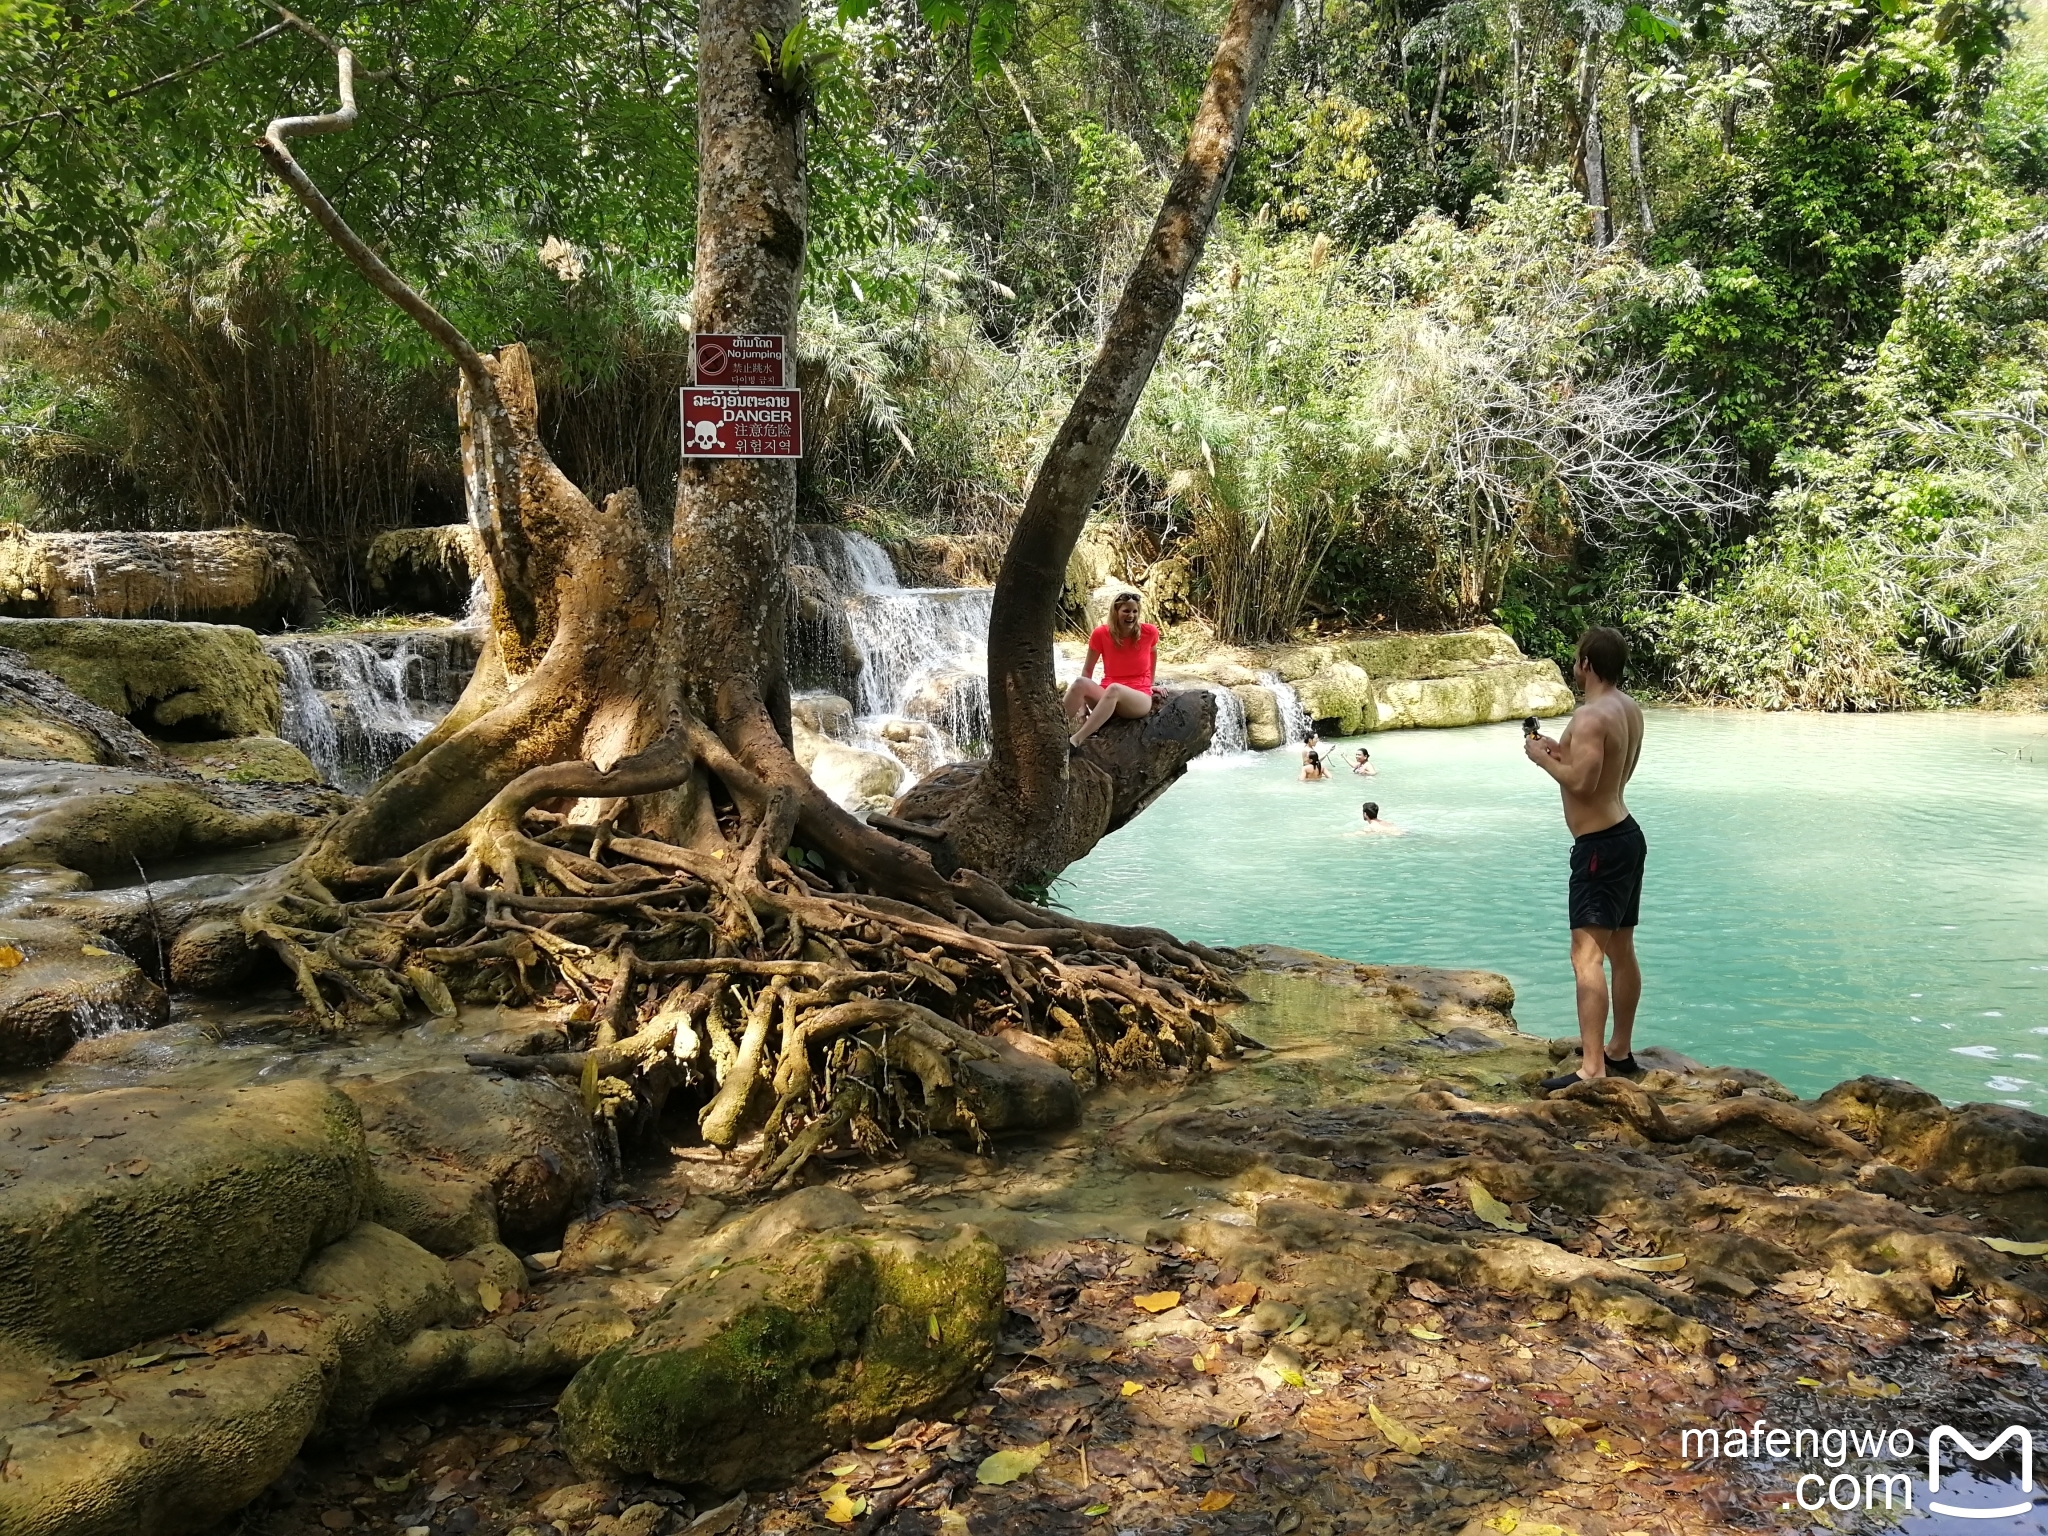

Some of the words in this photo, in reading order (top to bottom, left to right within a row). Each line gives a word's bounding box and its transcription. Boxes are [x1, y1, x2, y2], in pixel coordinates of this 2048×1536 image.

[727, 349, 741, 358] No
[742, 349, 782, 360] jumping
[732, 362, 773, 374] 禁止跳水
[731, 375, 756, 385] 다이빙
[759, 375, 775, 385] 금지
[723, 410, 792, 423] DANGER
[734, 423, 792, 437] 注意危险
